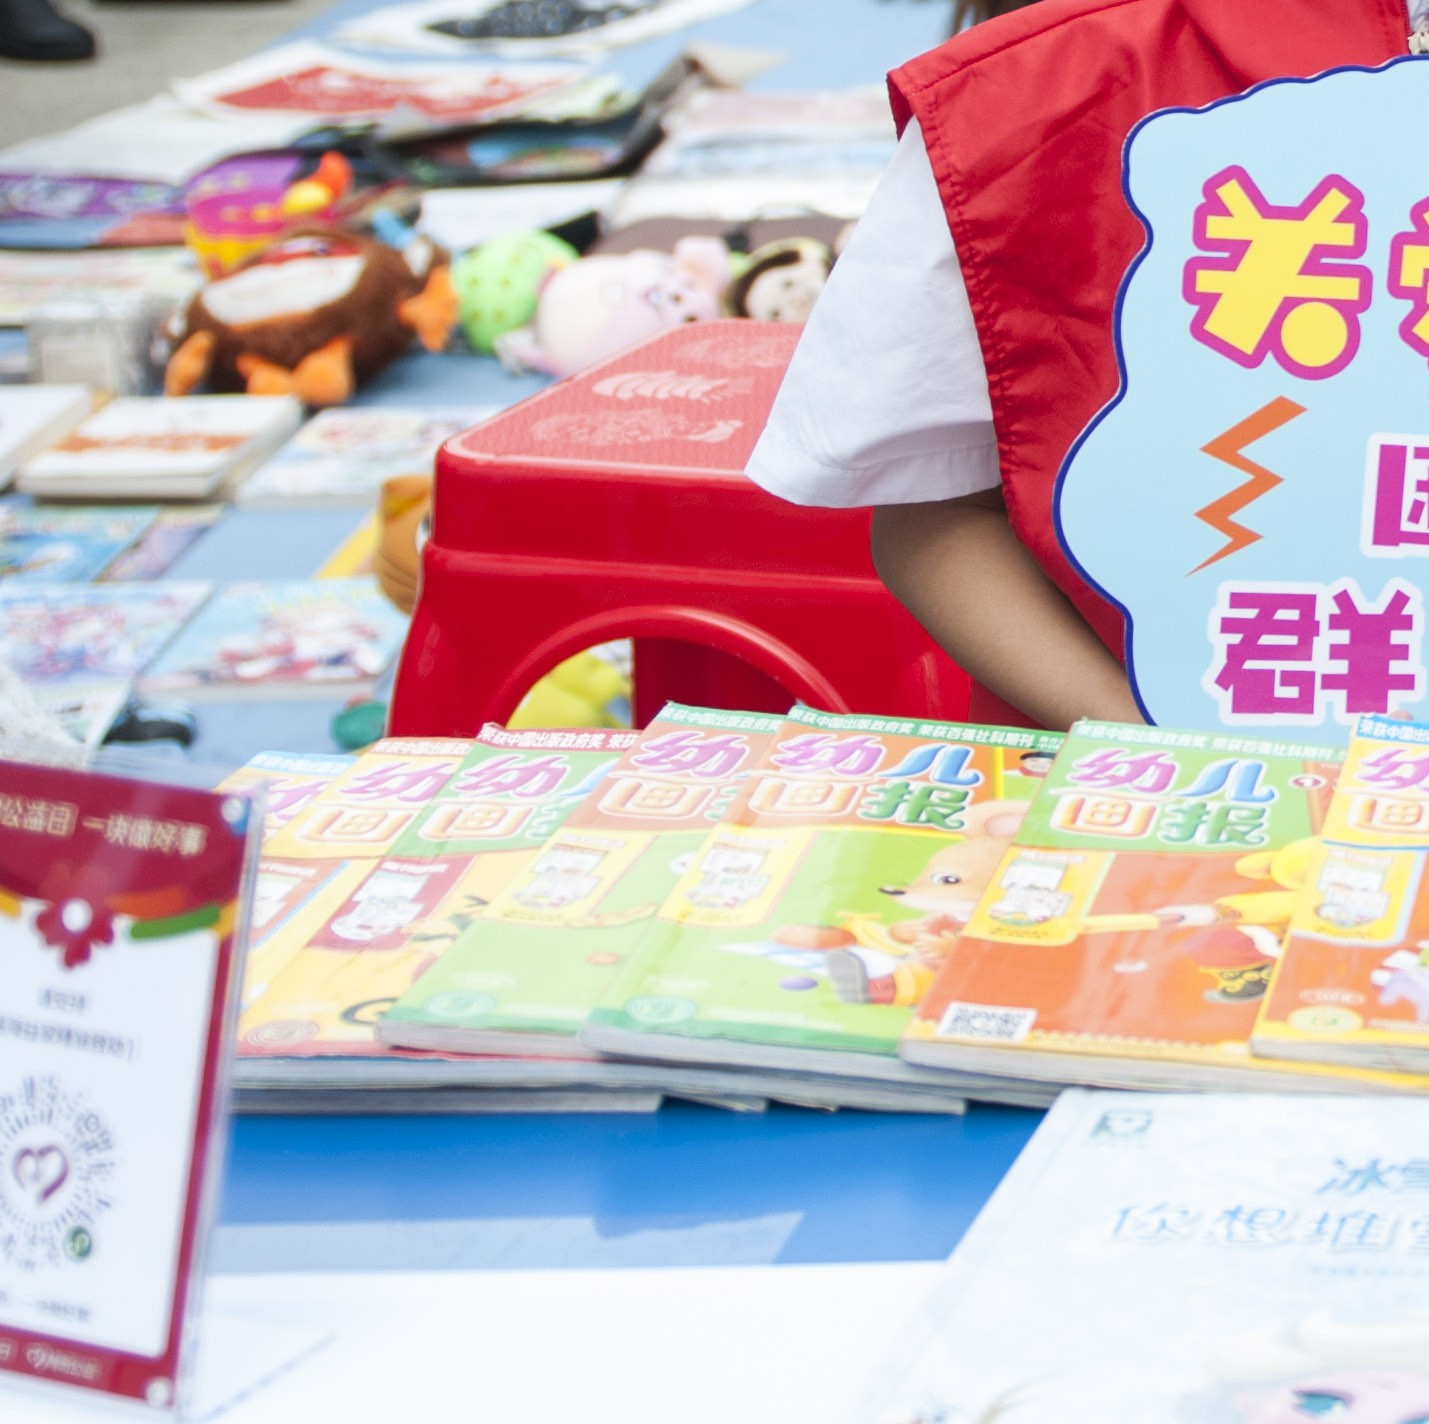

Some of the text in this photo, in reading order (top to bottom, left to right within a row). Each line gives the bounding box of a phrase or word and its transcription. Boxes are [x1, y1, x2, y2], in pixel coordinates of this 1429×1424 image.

[770, 733, 984, 786] 幼儿
[1065, 746, 1280, 806] 幼儿
[748, 769, 972, 831] 画报
[1047, 787, 1272, 848] 画报
